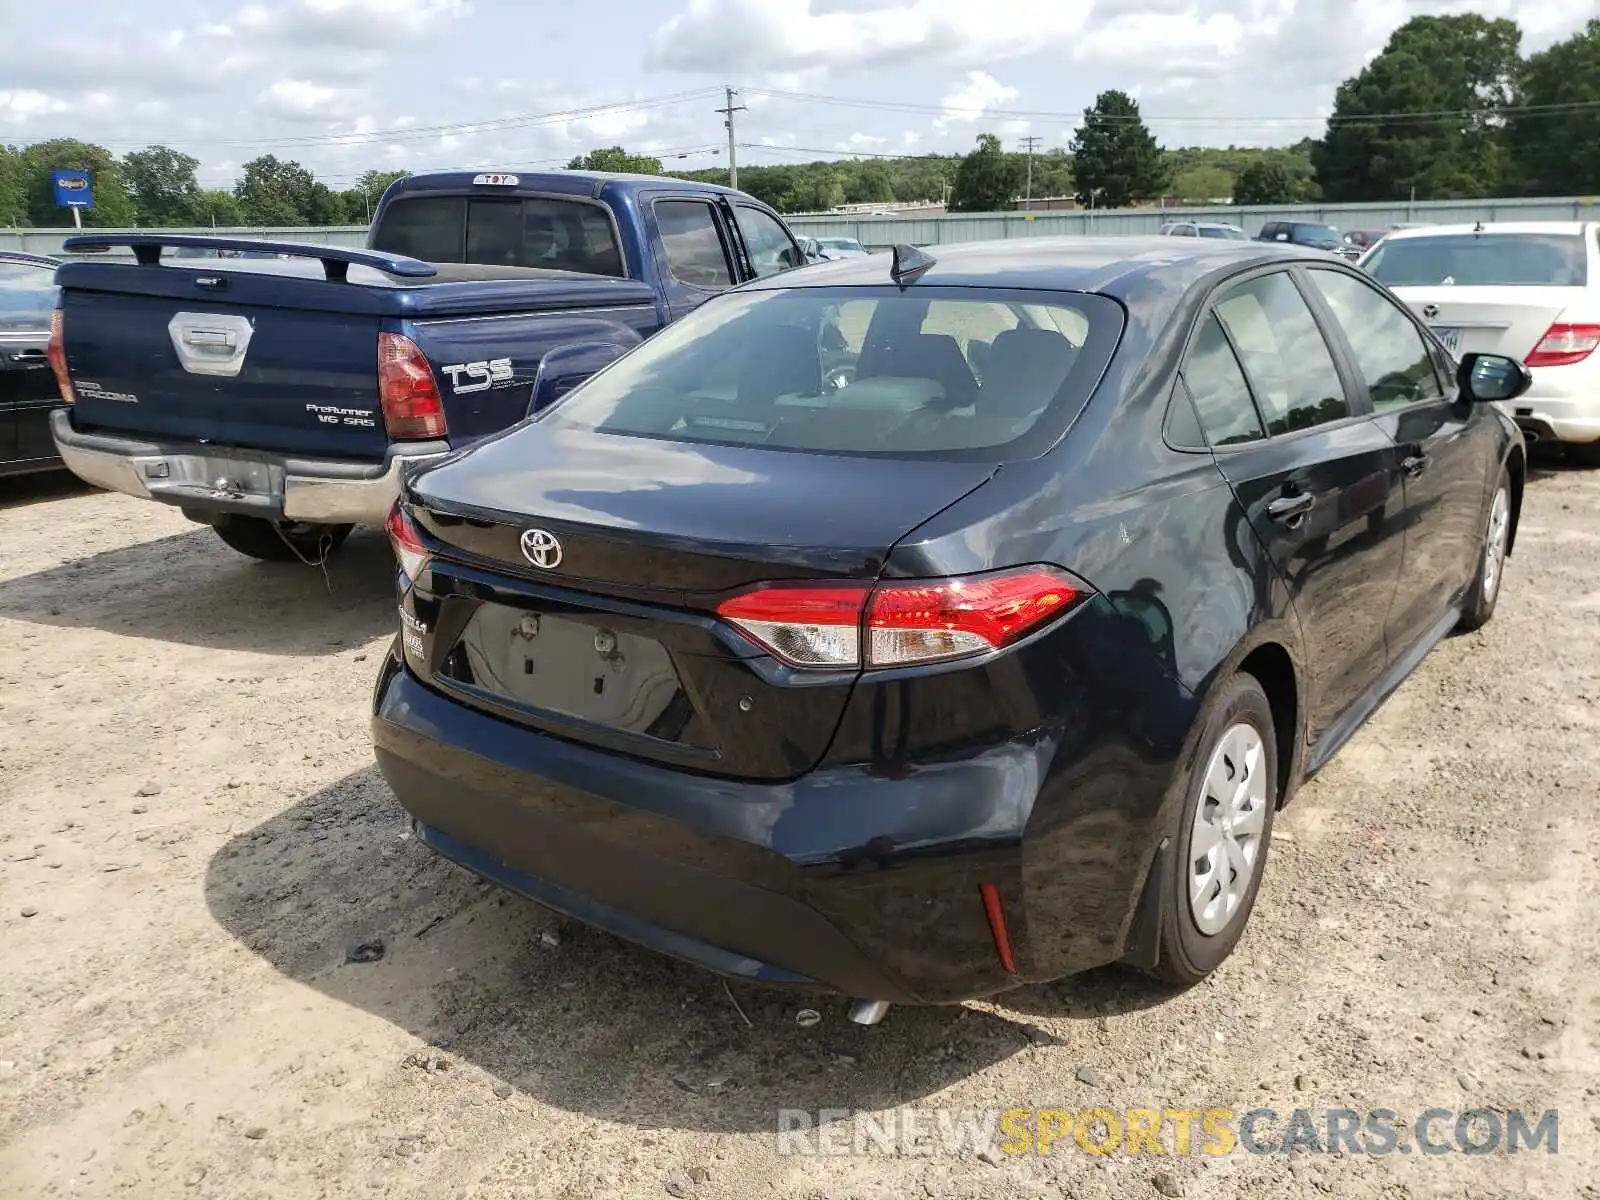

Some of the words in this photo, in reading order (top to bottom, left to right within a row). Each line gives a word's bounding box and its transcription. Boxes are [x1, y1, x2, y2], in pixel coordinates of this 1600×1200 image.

[484, 175, 508, 184] TOY
[441, 358, 514, 394] TSS
[306, 404, 373, 416] PreRunner
[318, 415, 338, 424] V6
